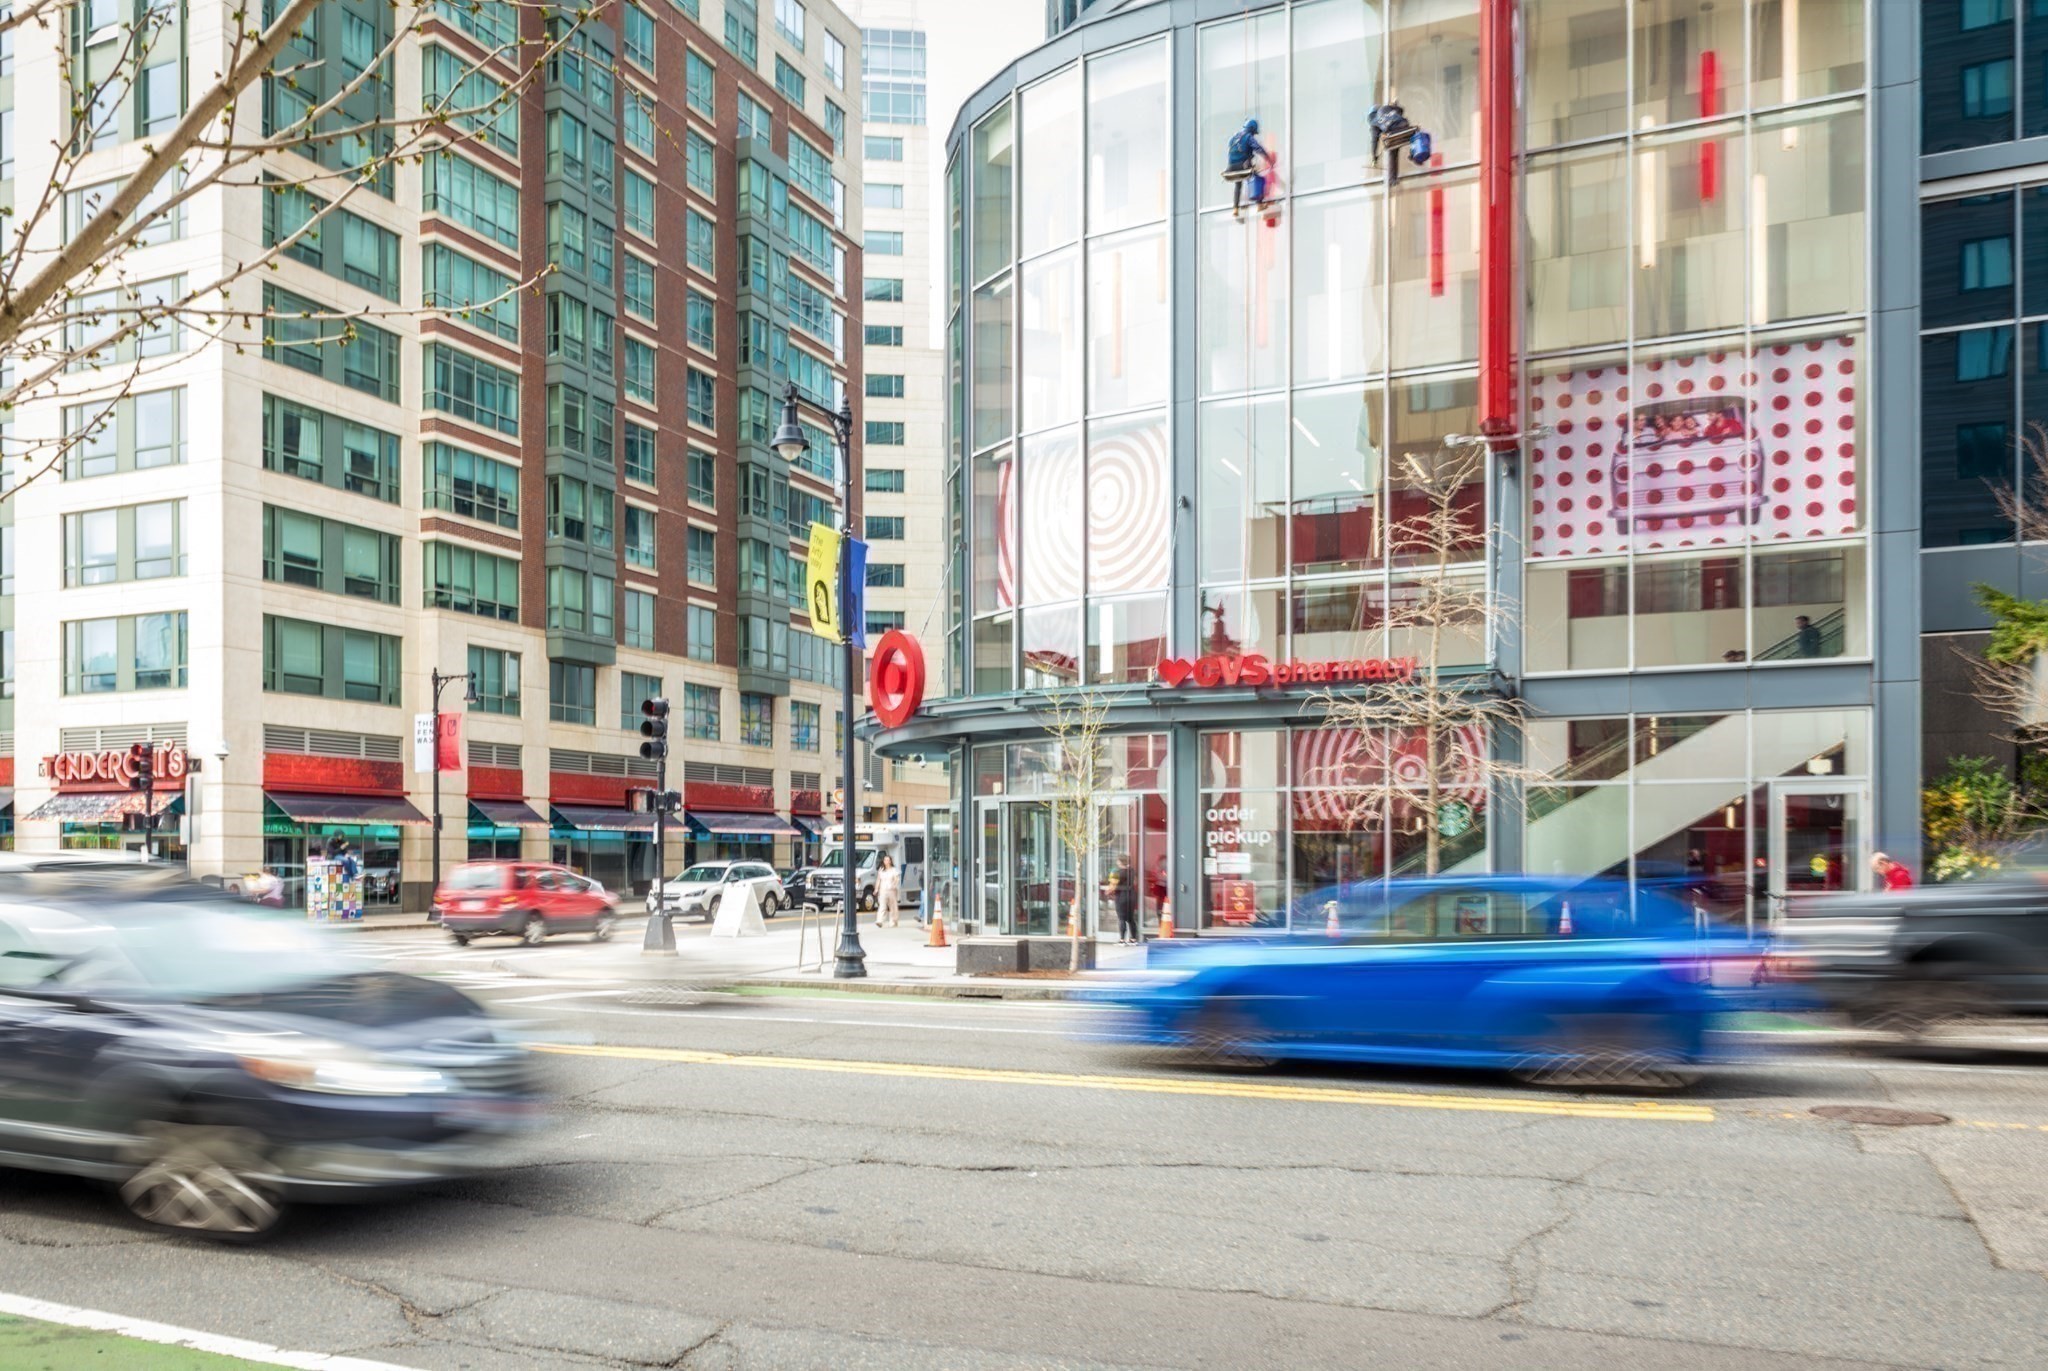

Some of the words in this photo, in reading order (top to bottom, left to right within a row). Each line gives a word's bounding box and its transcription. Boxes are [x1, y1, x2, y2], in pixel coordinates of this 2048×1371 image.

[1193, 654, 1269, 688] CVS
[1273, 656, 1416, 690] pharmacy
[889, 808, 898, 819] P
[1206, 805, 1257, 822] order
[1206, 827, 1271, 848] pickup
